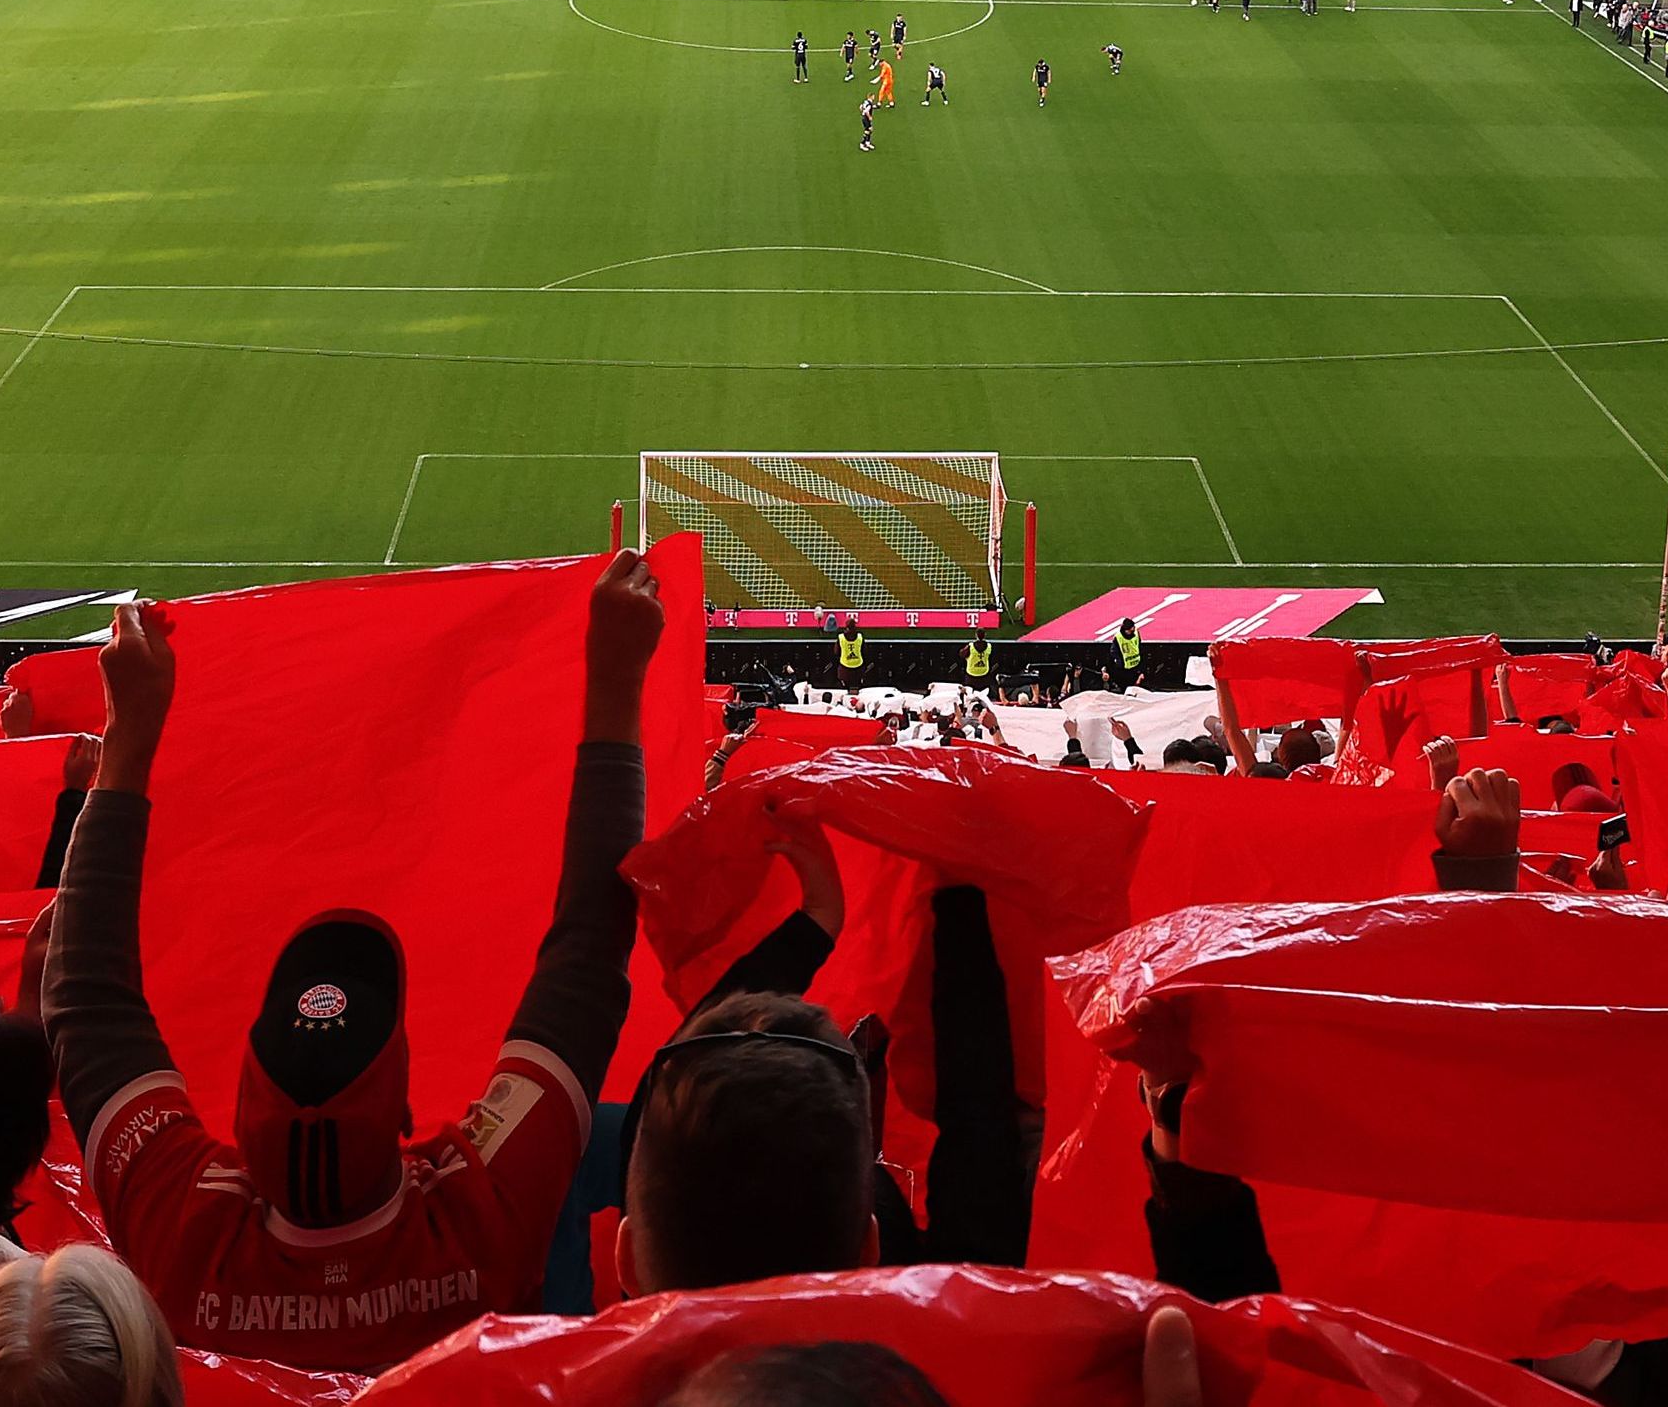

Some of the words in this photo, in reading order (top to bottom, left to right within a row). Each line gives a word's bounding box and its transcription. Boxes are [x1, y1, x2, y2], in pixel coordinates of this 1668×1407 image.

[196, 1299, 220, 1331] FC
[228, 1293, 340, 1331] BAYERN
[346, 1269, 479, 1329] MÜNCHEN
